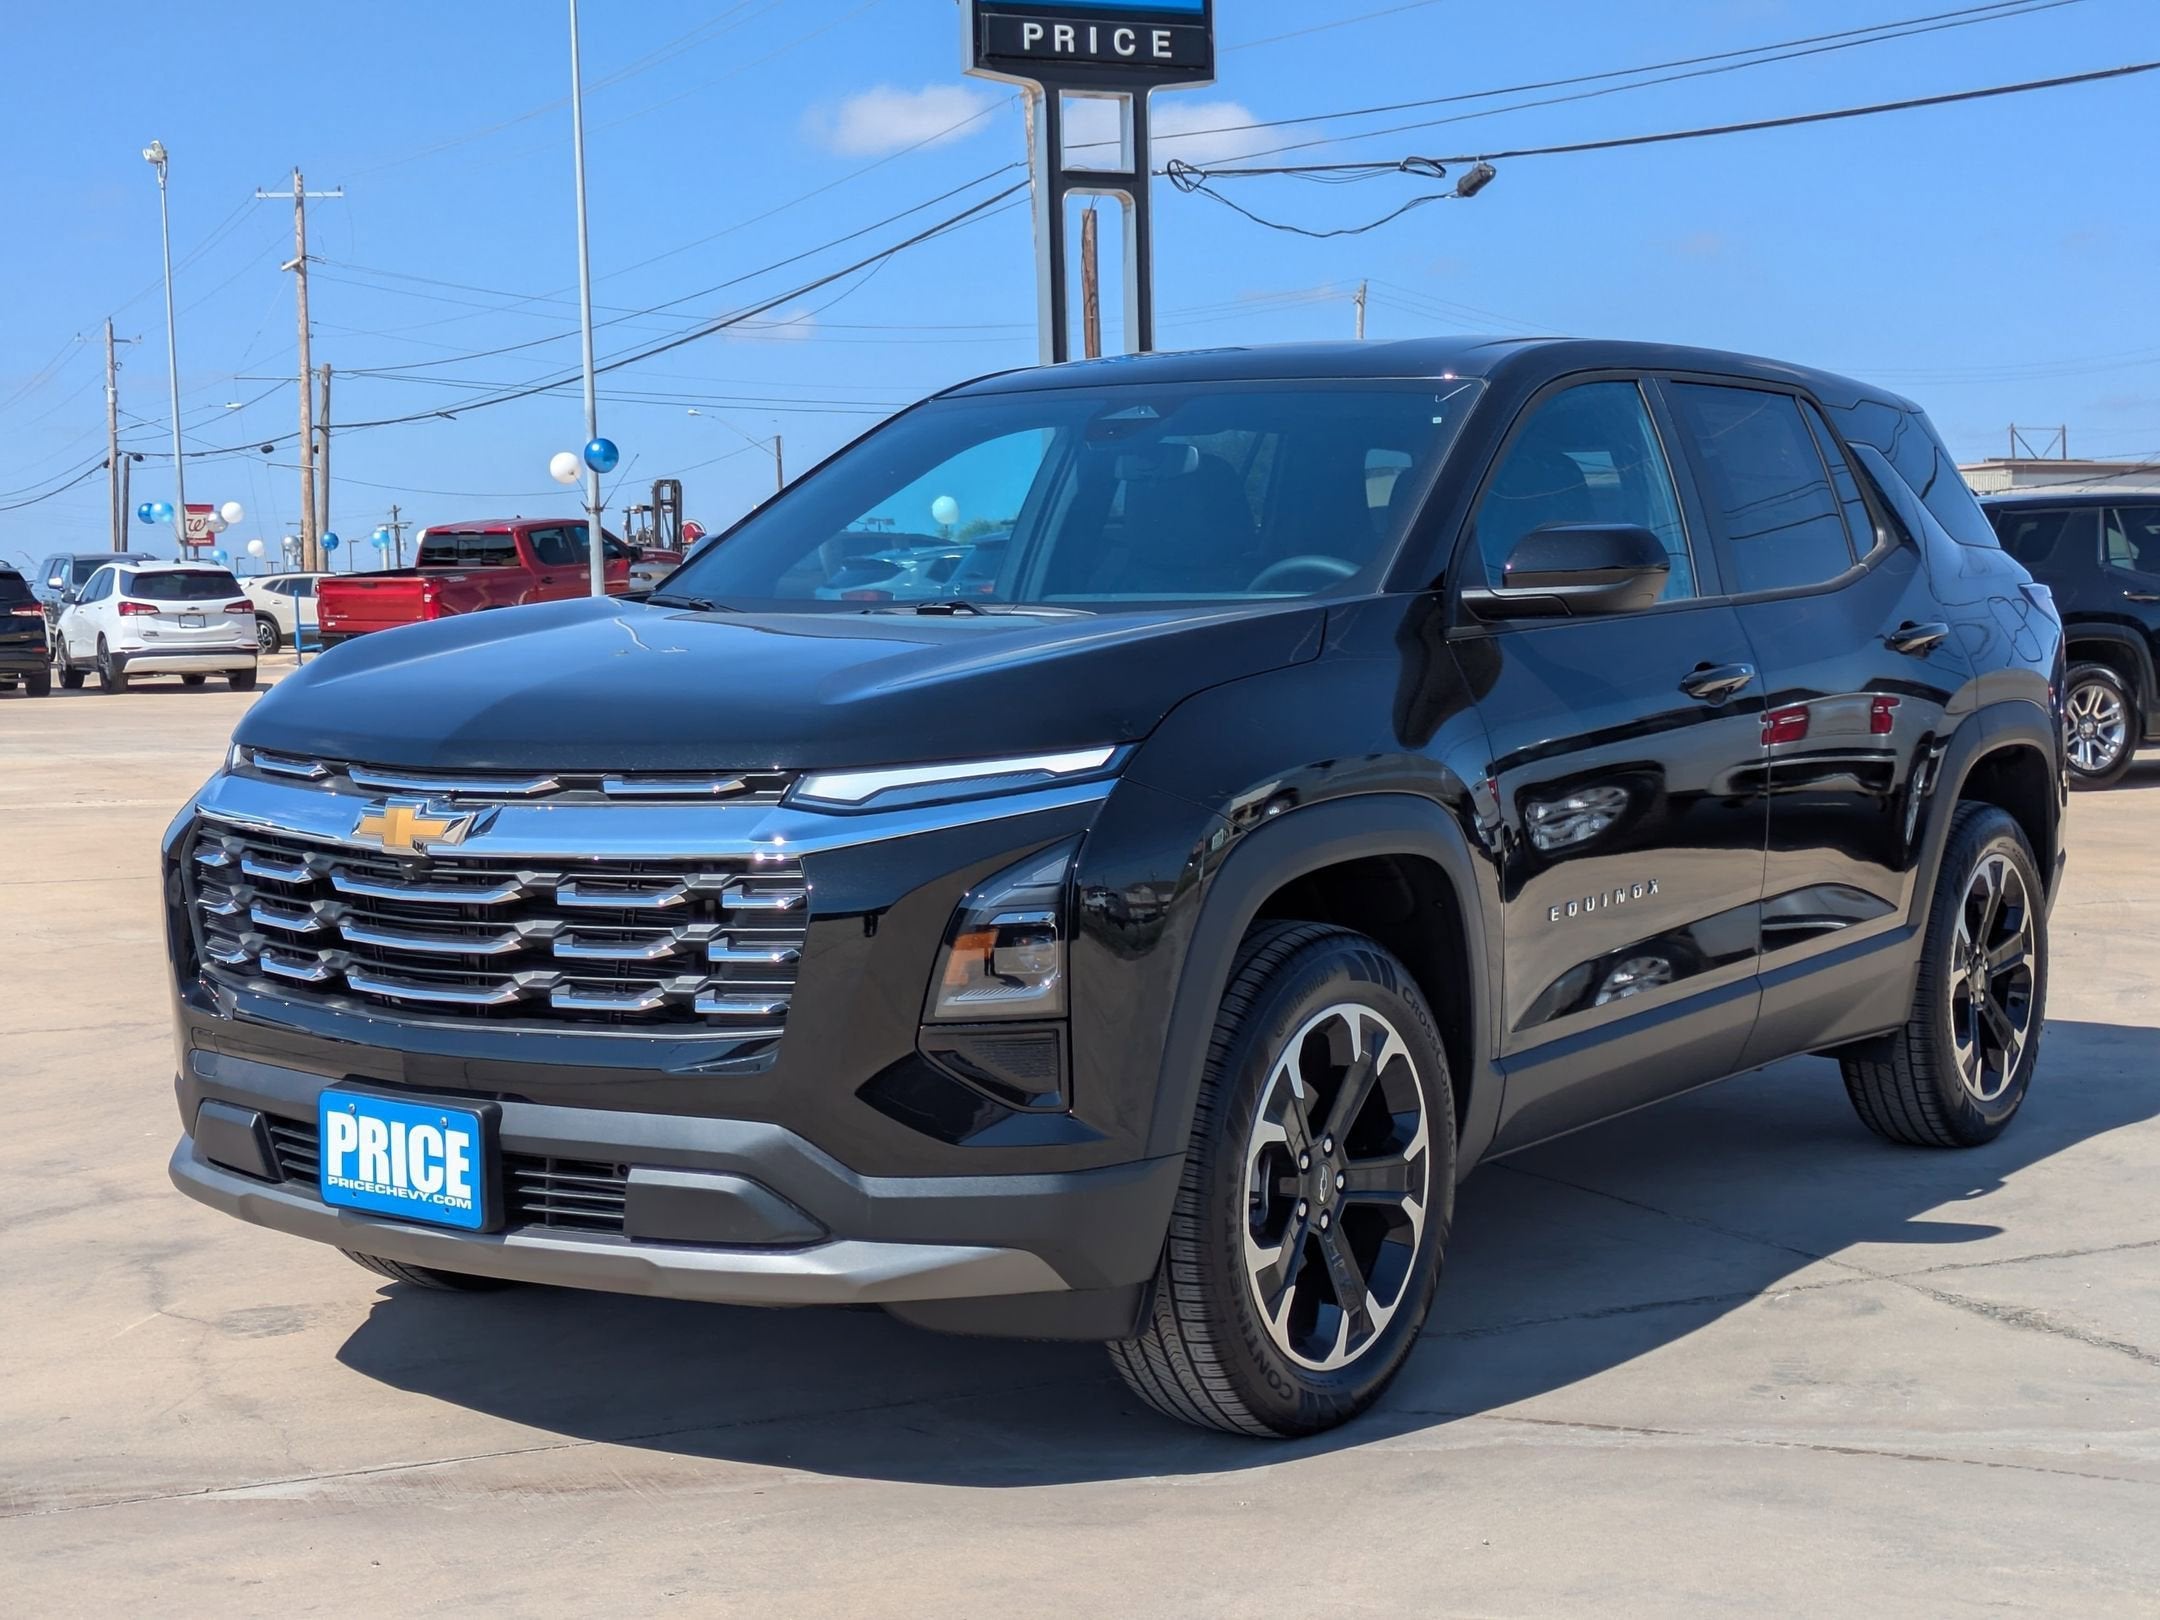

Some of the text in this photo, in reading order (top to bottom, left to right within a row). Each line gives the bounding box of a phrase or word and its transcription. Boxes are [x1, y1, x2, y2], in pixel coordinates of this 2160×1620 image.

[1023, 22, 1173, 58] PRICE
[1547, 879, 1660, 922] EQUINOX
[327, 1110, 473, 1200] PRICE
[327, 1175, 473, 1210] PRICECHEVY.COM
